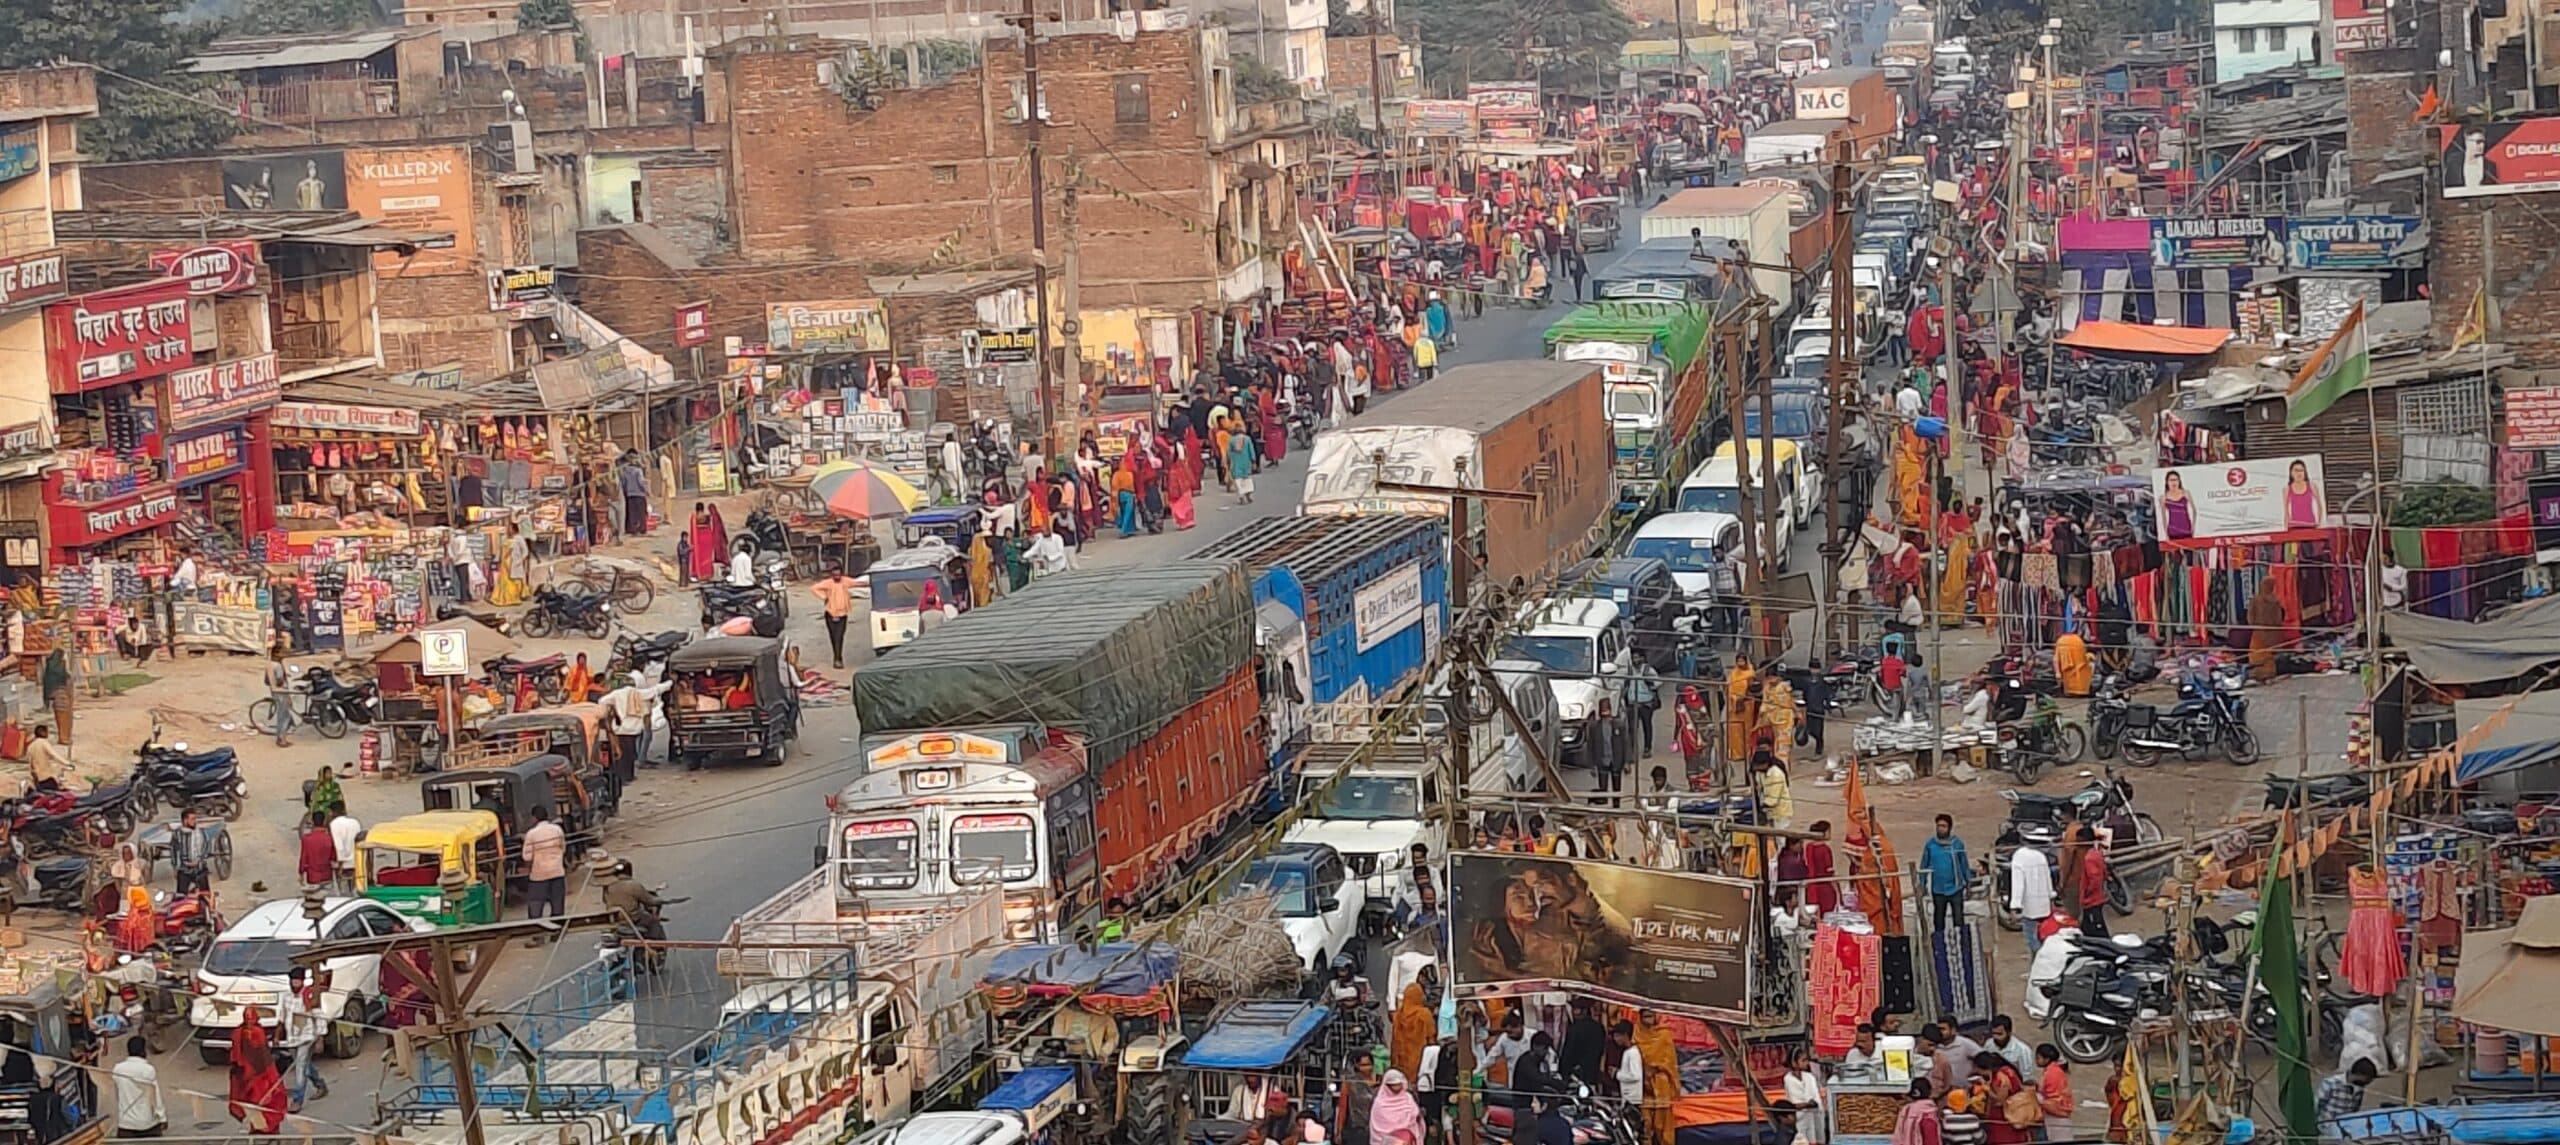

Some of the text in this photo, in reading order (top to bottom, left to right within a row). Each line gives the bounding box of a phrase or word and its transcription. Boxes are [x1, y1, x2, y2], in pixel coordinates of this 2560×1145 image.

[1800, 87, 1845, 109] NAC
[364, 161, 427, 179] KILLER
[183, 252, 230, 277] MASTER
[75, 299, 186, 346] बिहार बूट हाउस
[240, 354, 276, 386] हाउस
[176, 433, 224, 463] MASTER
[88, 510, 123, 534] बिहार
[145, 495, 176, 520] हाउस
[1632, 917, 1668, 938] TERE
[1704, 925, 1742, 944] MEIN
